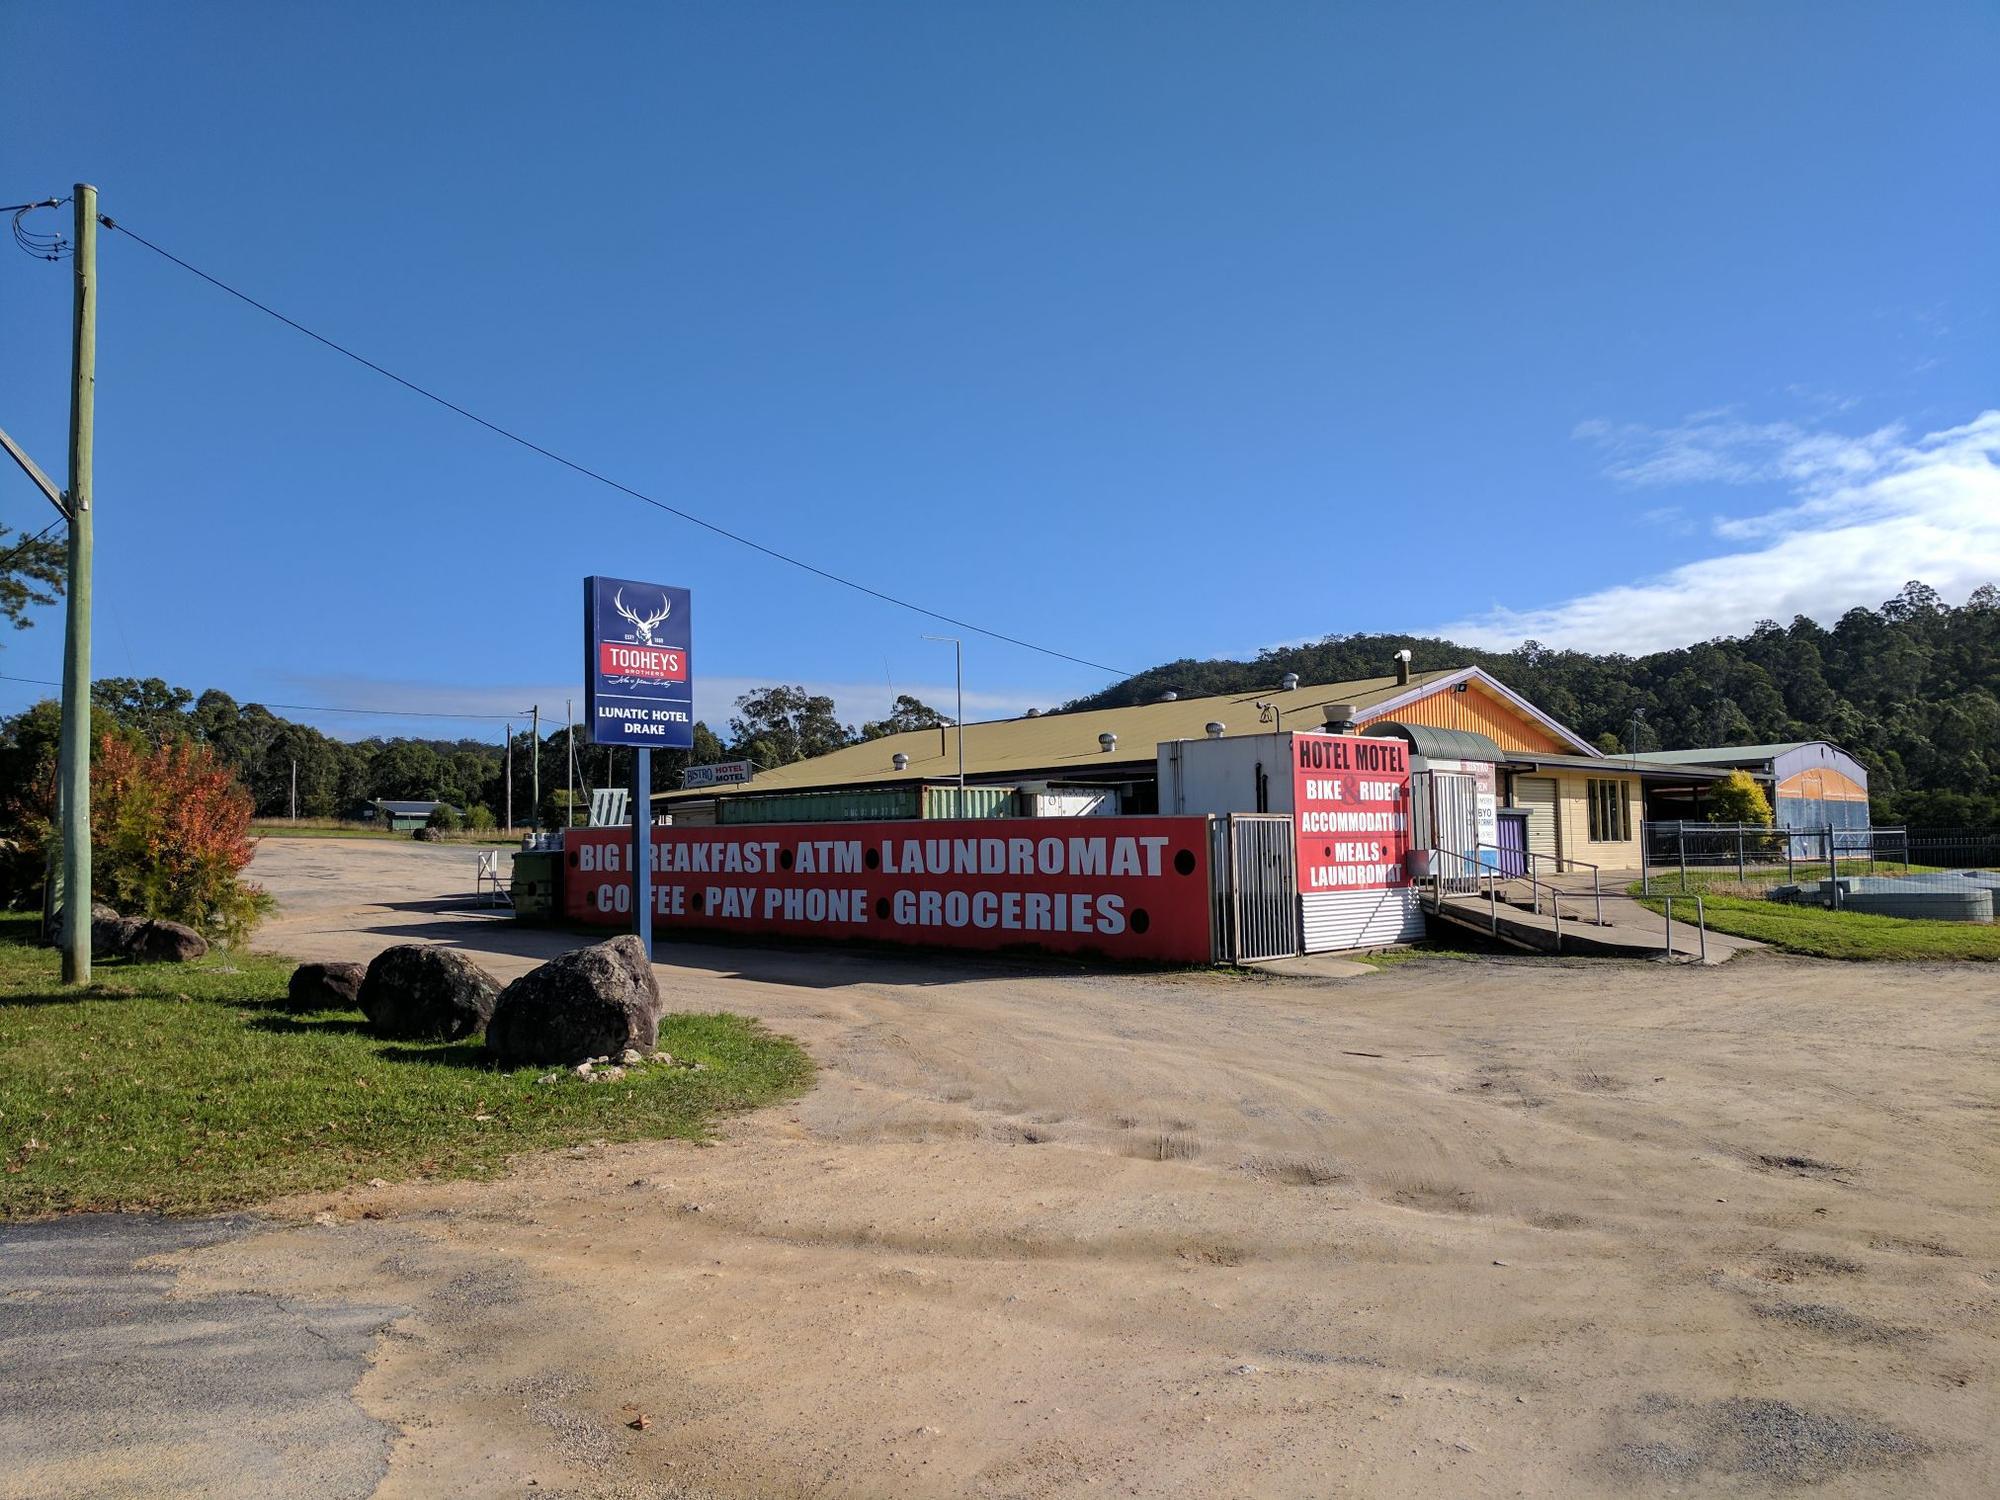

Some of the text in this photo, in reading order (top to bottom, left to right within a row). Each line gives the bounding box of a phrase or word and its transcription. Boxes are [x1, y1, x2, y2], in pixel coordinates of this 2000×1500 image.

[609, 648, 678, 672] TOOHEYS
[624, 668, 664, 677] BROTHERS
[599, 707, 689, 722] LUNATIC HOTEL
[624, 723, 665, 735] DRAKE
[1300, 740, 1405, 772] HOTEL MOTEL
[715, 764, 744, 774] HOTEL
[715, 773, 746, 782] MOTEL
[1306, 779, 1342, 800] BIKE
[1359, 781, 1401, 801] RIDER
[1302, 811, 1408, 833] ACCOMMODATION
[580, 843, 620, 872] BIG
[794, 840, 863, 874] ATM
[881, 836, 1169, 877] LAUNDROMAT
[1334, 842, 1380, 862] MEALS
[1310, 863, 1403, 887] LAUNDROMAT
[597, 884, 1126, 935] COEE PAY PHONE GROCERIES
